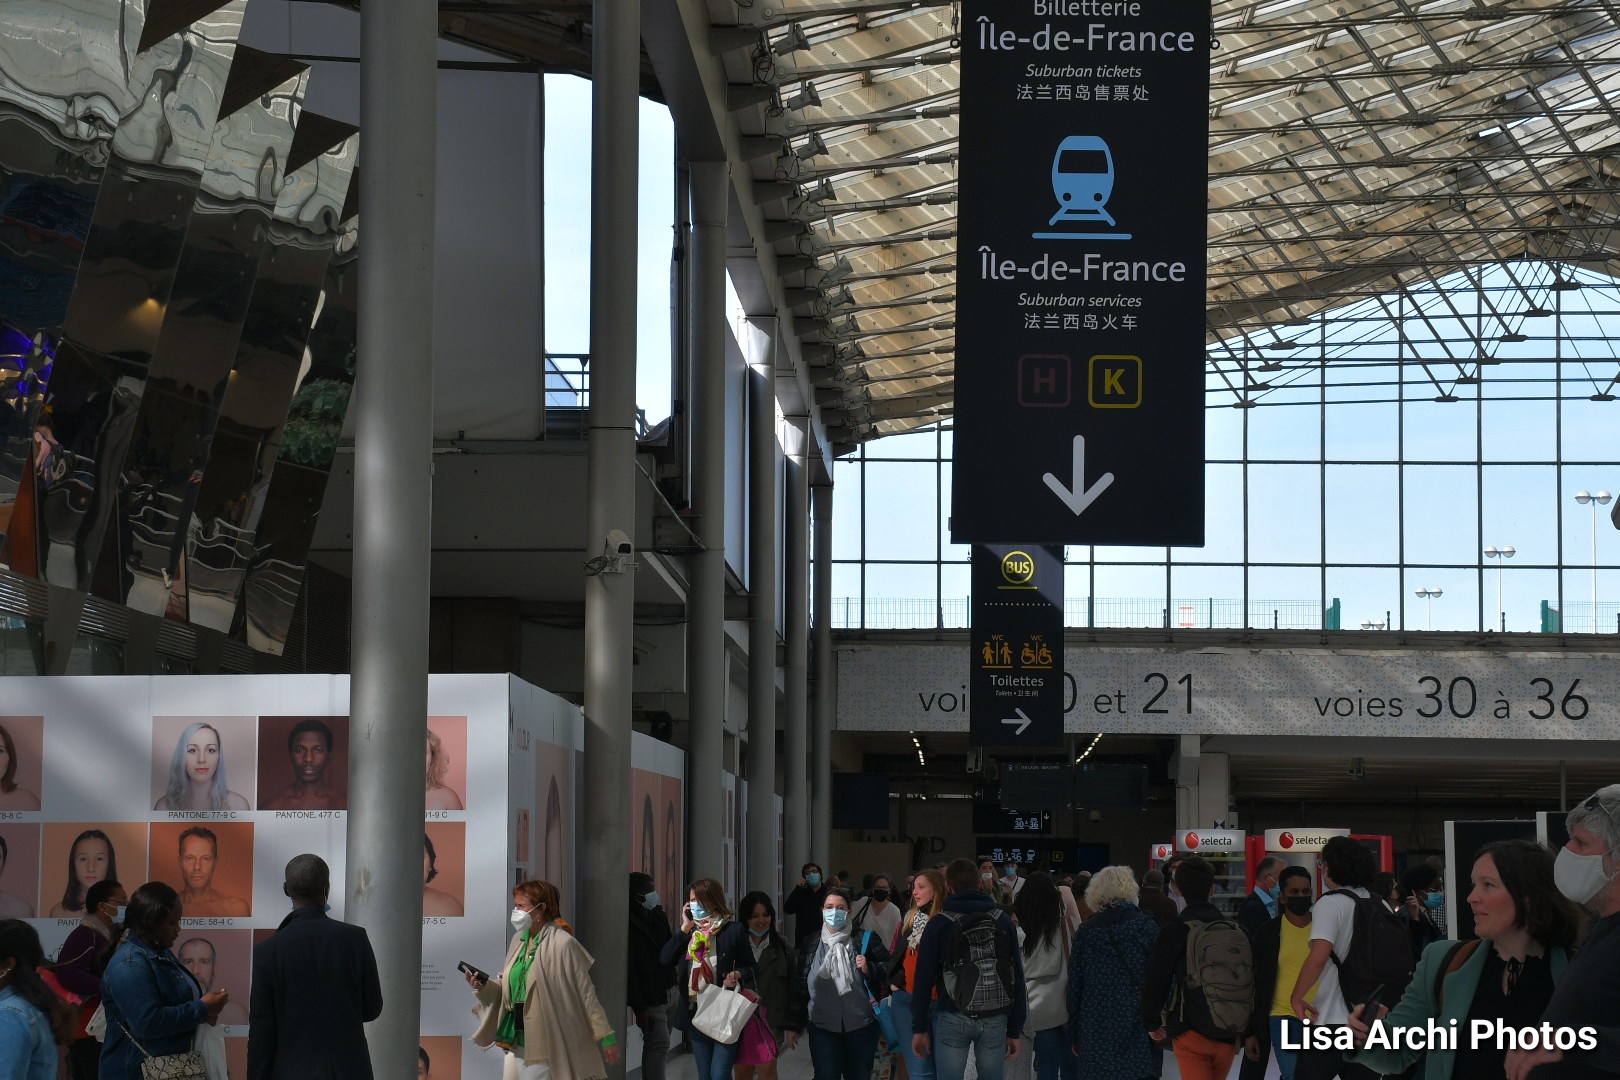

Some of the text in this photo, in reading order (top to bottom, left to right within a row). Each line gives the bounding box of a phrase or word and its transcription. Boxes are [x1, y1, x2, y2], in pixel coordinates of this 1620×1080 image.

[1034, 0, 1141, 17] Billetterie
[976, 15, 1195, 52] Île-de-France
[1025, 64, 1142, 78] Suburban tickets
[1016, 83, 1150, 101] 法兰西岛售票处
[978, 245, 1186, 282] Île-de-France
[1018, 292, 1142, 308] Suburban services
[1024, 312, 1138, 331] 法兰西岛火车
[1033, 367, 1126, 395] H K
[1005, 561, 1030, 574] BUS
[990, 675, 1044, 687] Toilettes
[918, 684, 966, 712] voi
[1093, 688, 1127, 714] et
[1142, 671, 1192, 715] 21
[1314, 675, 1590, 721] voies 30 à 36
[211, 811, 228, 819] 77-9
[230, 811, 237, 819] C
[318, 811, 333, 819] 477
[334, 811, 341, 819] C
[441, 811, 448, 819] C
[1200, 836, 1232, 846] selecta
[1295, 835, 1327, 845] selecta
